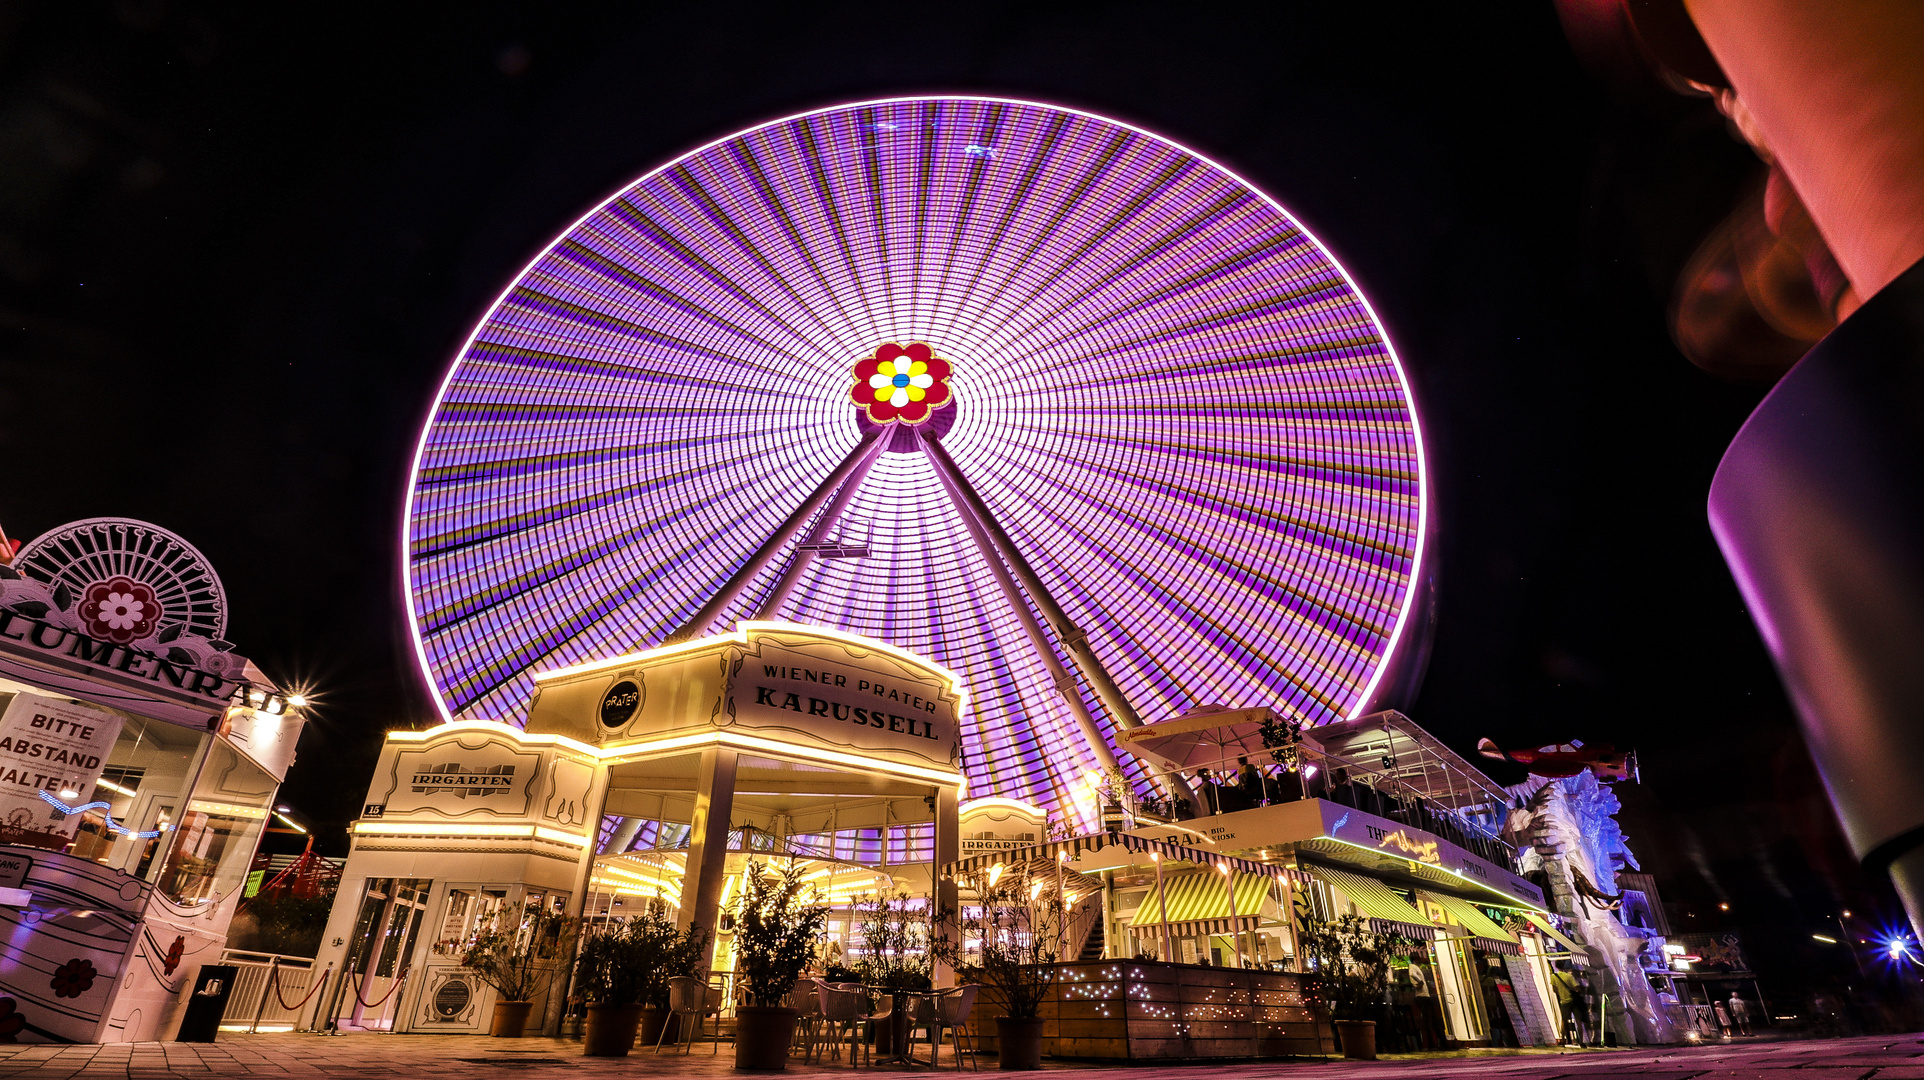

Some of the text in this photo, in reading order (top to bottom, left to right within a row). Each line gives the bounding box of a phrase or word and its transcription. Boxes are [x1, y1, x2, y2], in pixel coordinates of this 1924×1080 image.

[0, 608, 289, 716] LUMENRAD
[764, 665, 936, 714] WIENER PRATER
[605, 691, 638, 710] PRATER
[755, 686, 938, 740] KARUSSELL
[30, 713, 95, 740] BITTE
[0, 736, 100, 770] ABSTAND
[411, 775, 513, 786] IRRGARTEN
[368, 805, 380, 814] 15
[1211, 827, 1225, 835] BIO
[1212, 833, 1236, 841] KIOSK
[0, 860, 20, 870] ANG
